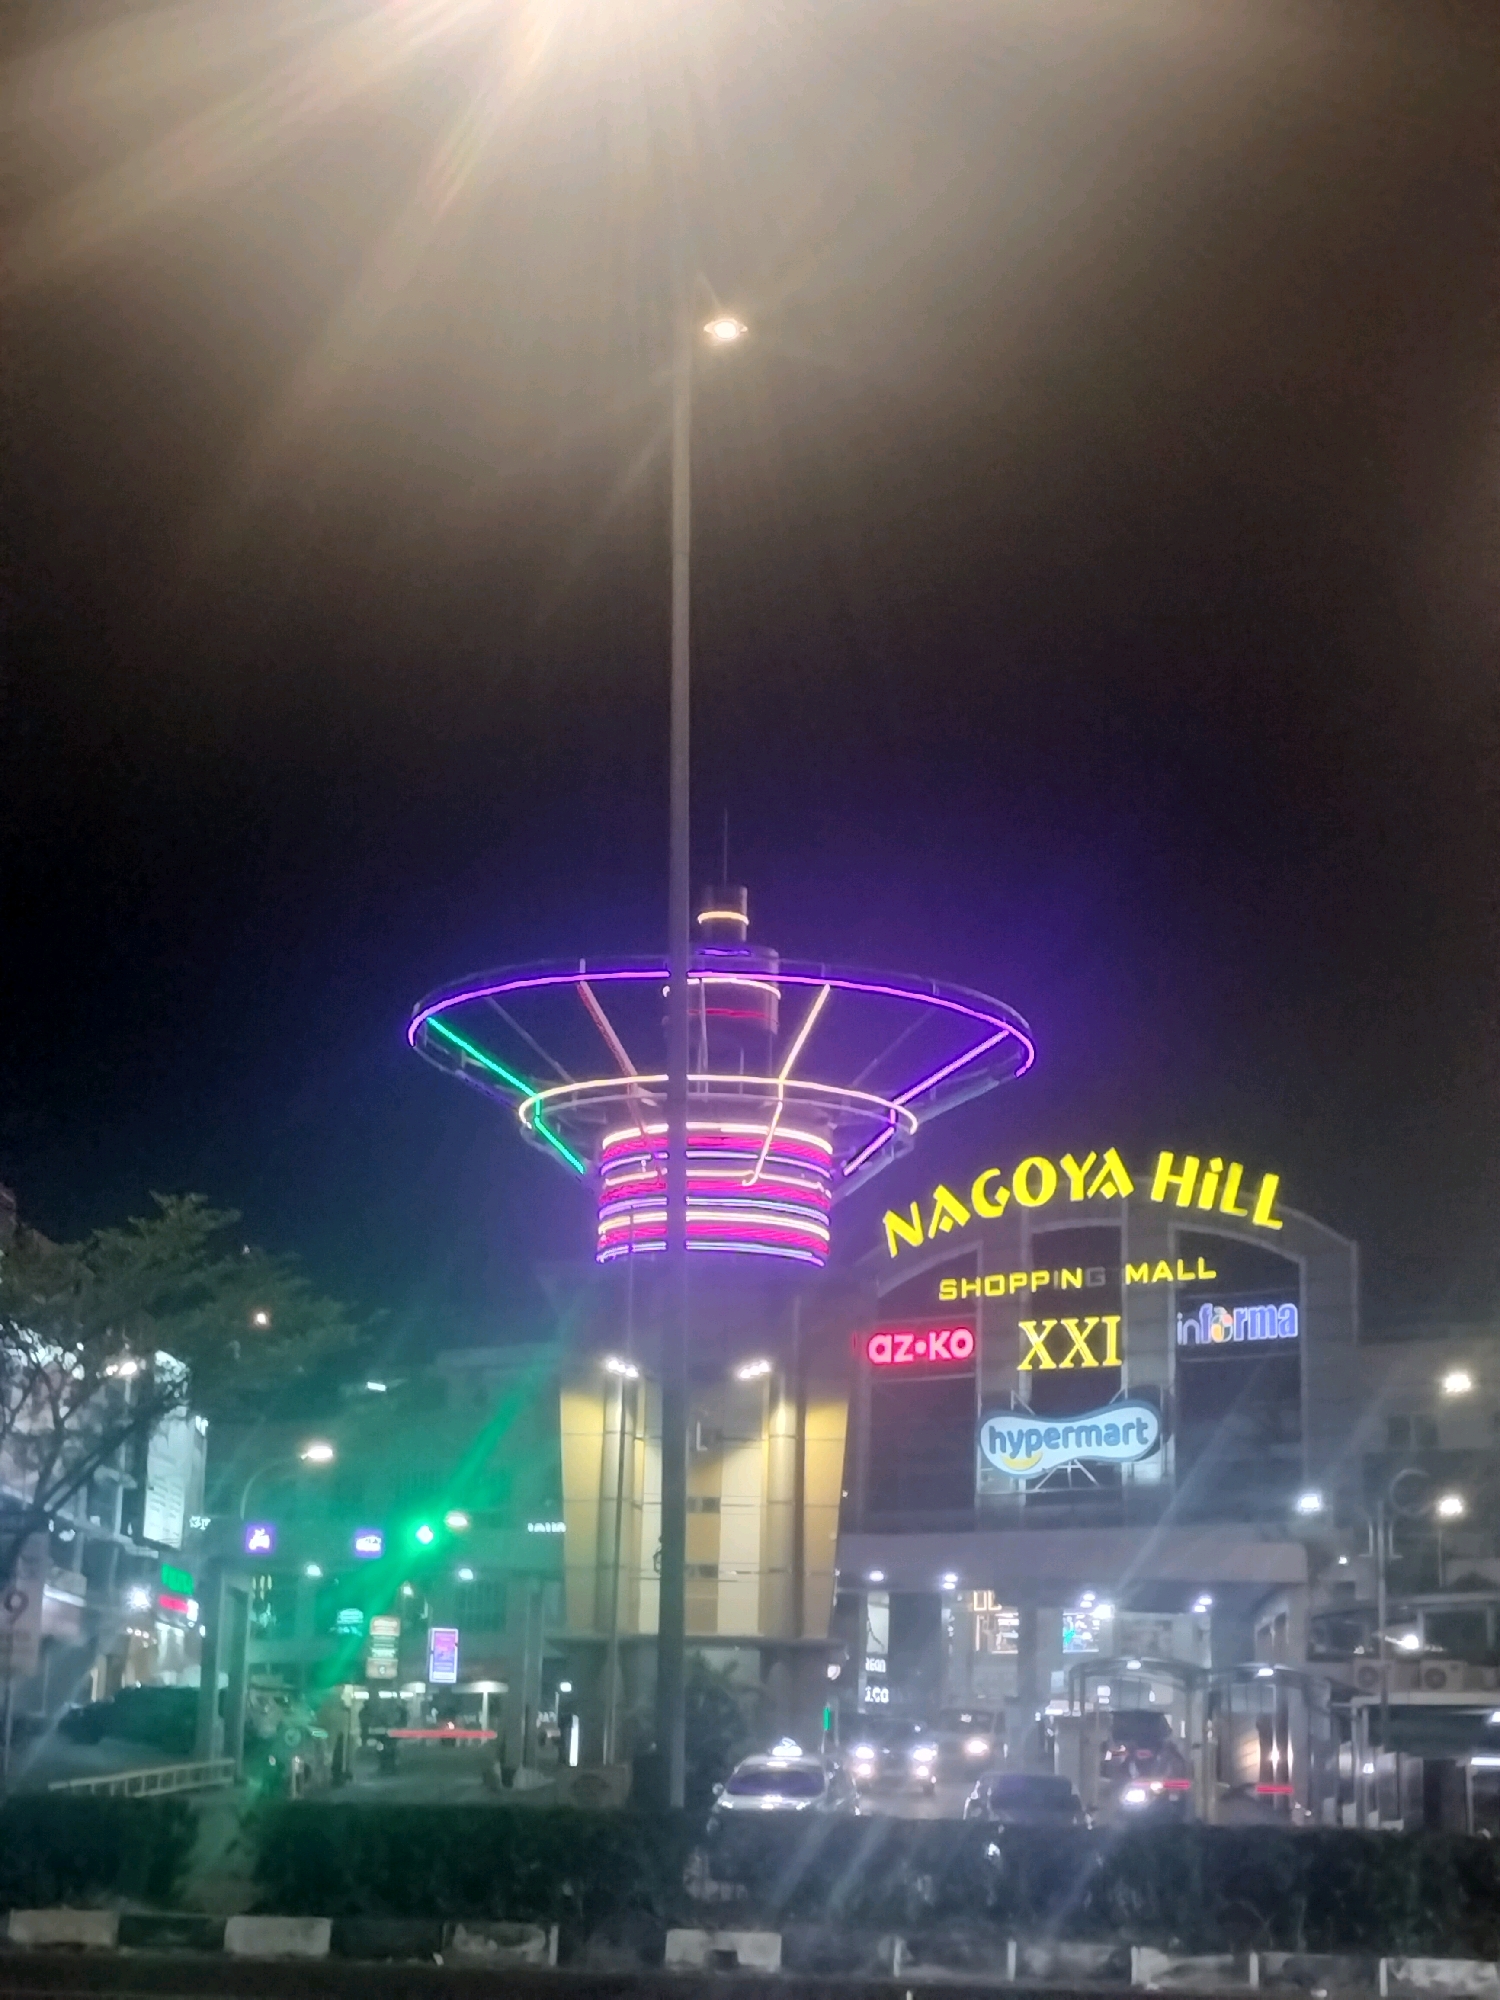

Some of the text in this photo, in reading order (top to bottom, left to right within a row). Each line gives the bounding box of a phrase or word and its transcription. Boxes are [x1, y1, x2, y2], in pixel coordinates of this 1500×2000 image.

[883, 1147, 1134, 1258] NAGOYA
[938, 1257, 1217, 1301] SHOPPING MALL
[1017, 1315, 1122, 1370] XXI
[1177, 1303, 1298, 1345] informa
[988, 1417, 1149, 1459] hypermart
